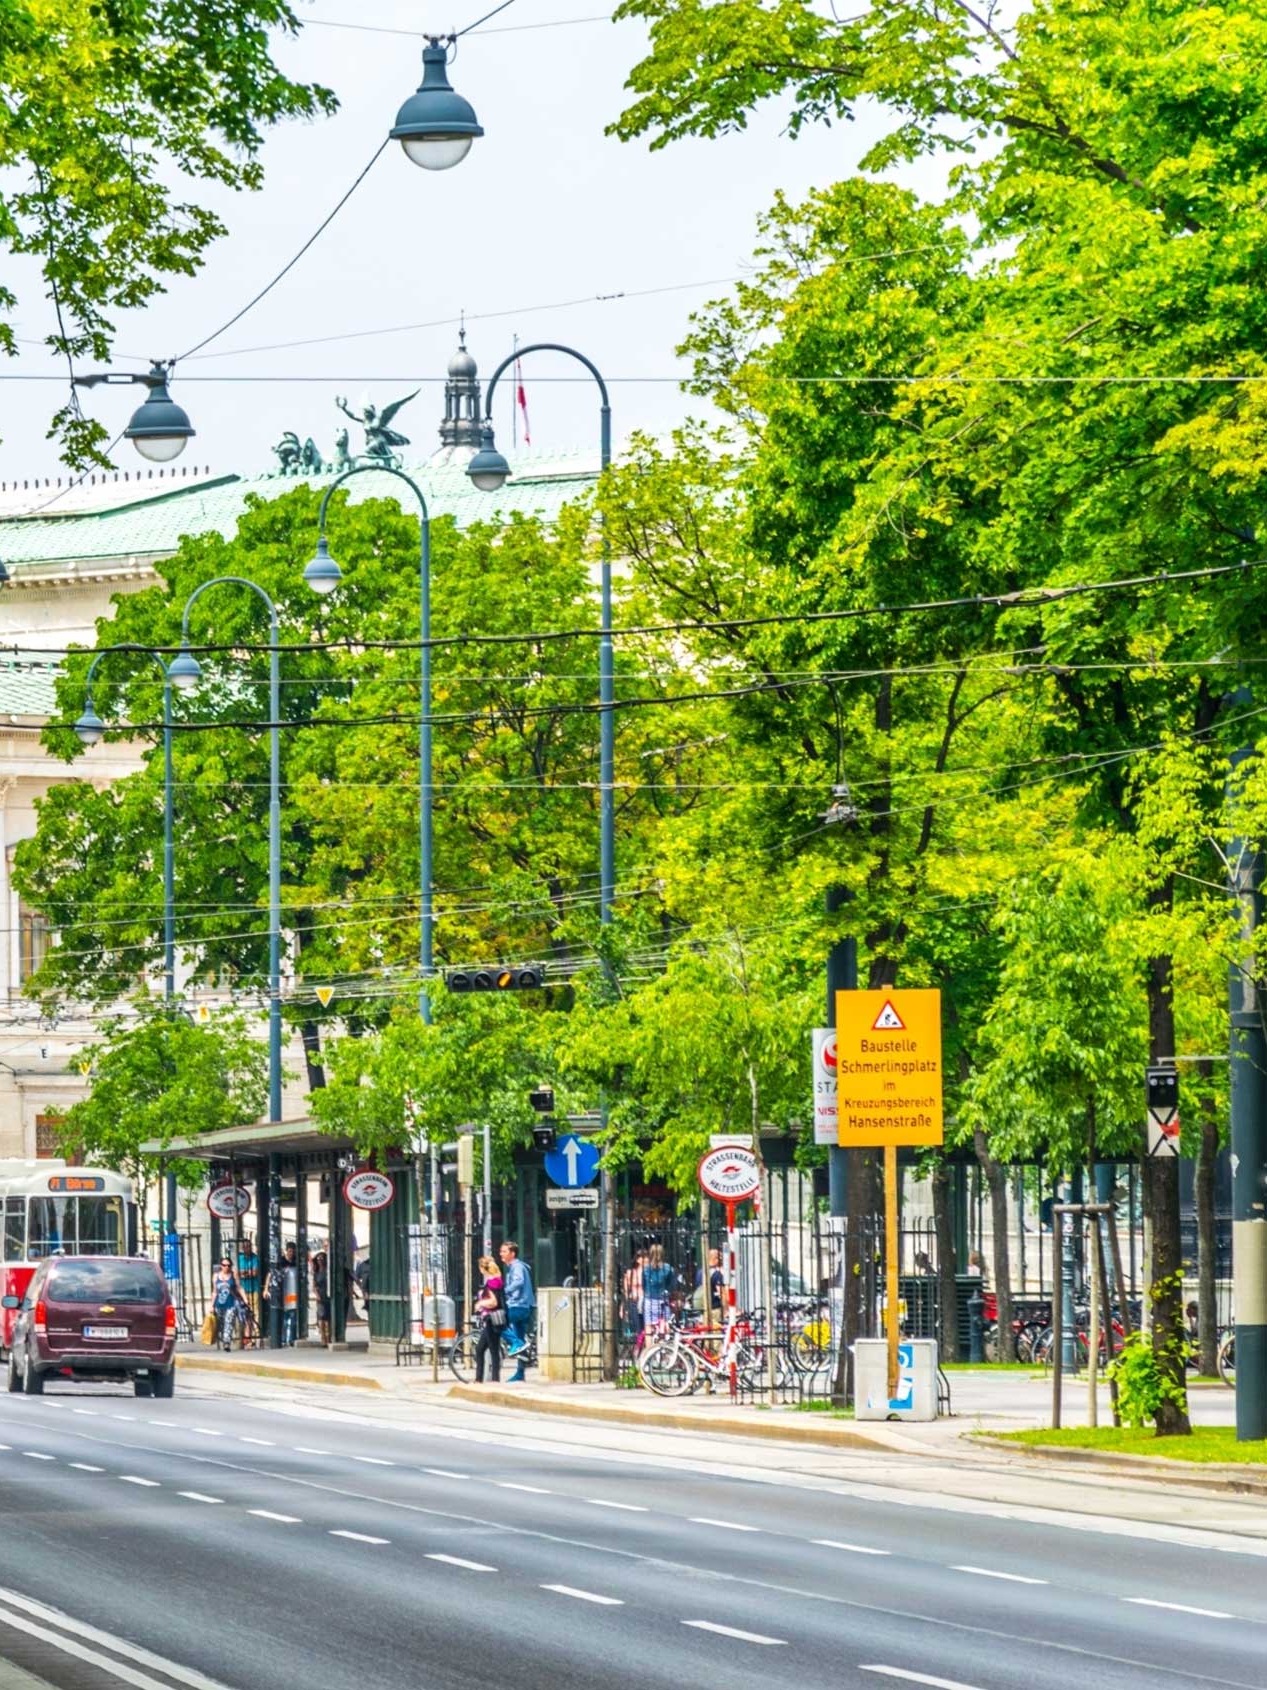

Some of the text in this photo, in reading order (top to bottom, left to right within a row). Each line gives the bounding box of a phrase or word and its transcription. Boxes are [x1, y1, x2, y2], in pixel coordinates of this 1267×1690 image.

[861, 1039, 917, 1053] Baustelle
[841, 1059, 937, 1076] Schmerlingplatz
[883, 1080, 897, 1092] im
[844, 1096, 936, 1111] Kreuzungsbereich
[848, 1113, 932, 1128] Hansenstraße
[706, 1152, 755, 1170] STRASSENBAHN
[710, 1177, 756, 1193] HALTESTELLE
